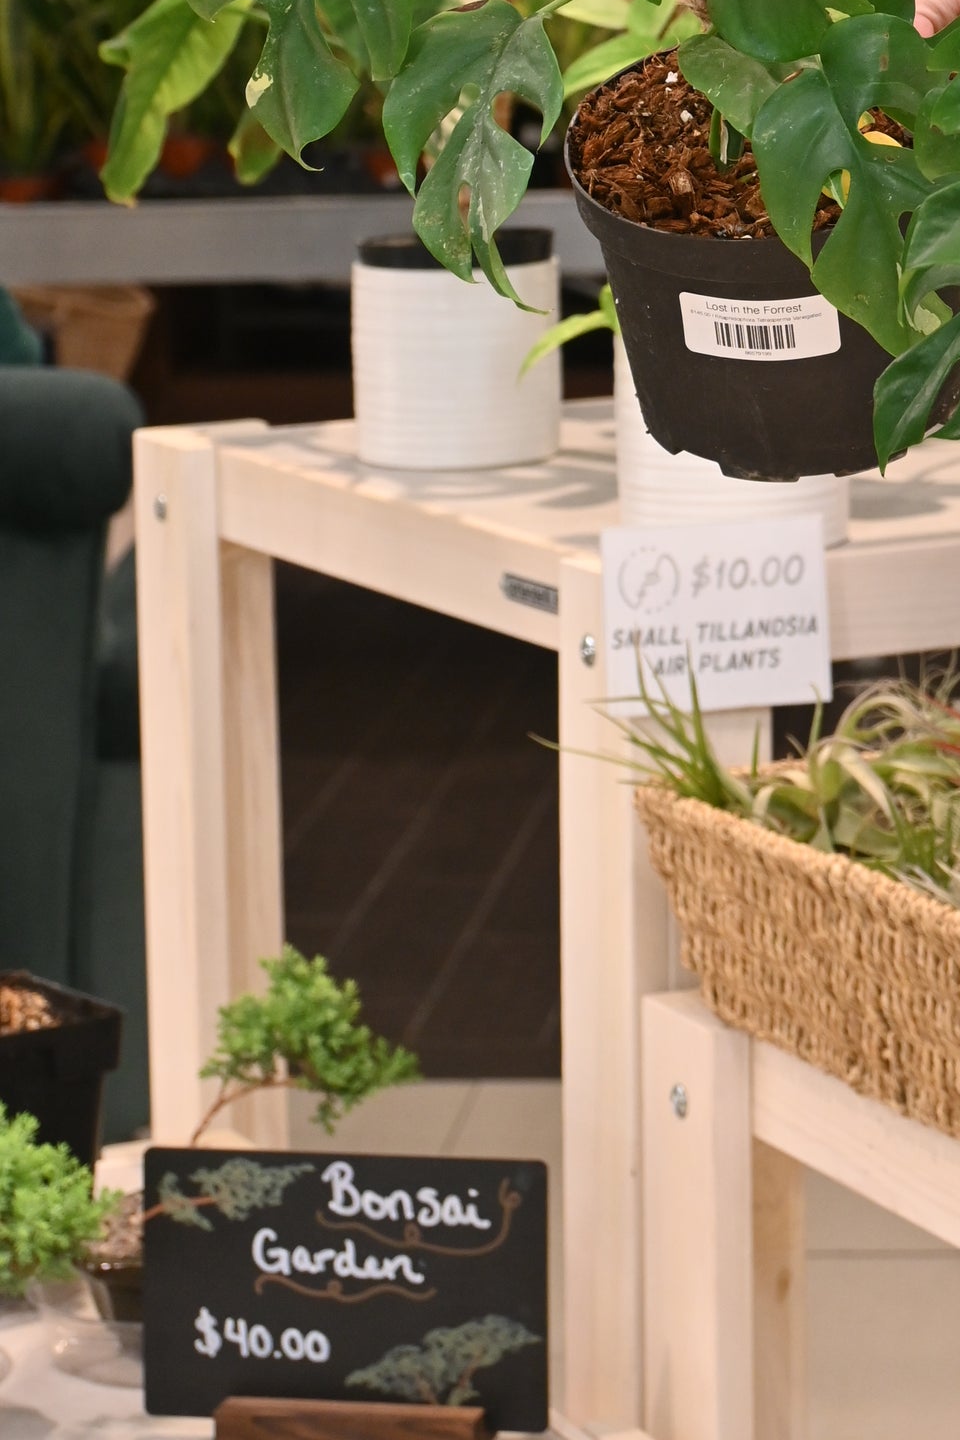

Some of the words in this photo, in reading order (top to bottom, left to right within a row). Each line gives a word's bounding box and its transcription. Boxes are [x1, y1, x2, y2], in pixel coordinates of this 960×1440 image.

[706, 300, 727, 313] Lost
[730, 304, 741, 314] in
[743, 305, 760, 315] the
[763, 303, 803, 315] Forrest
[691, 553, 806, 598] $10.00
[611, 625, 682, 650] SMALL
[653, 656, 686, 675] AIR
[699, 647, 782, 673] PLANTS
[321, 1160, 493, 1231] Bonsai
[251, 1226, 426, 1285] Garden
[194, 1305, 332, 1363] $40.00
